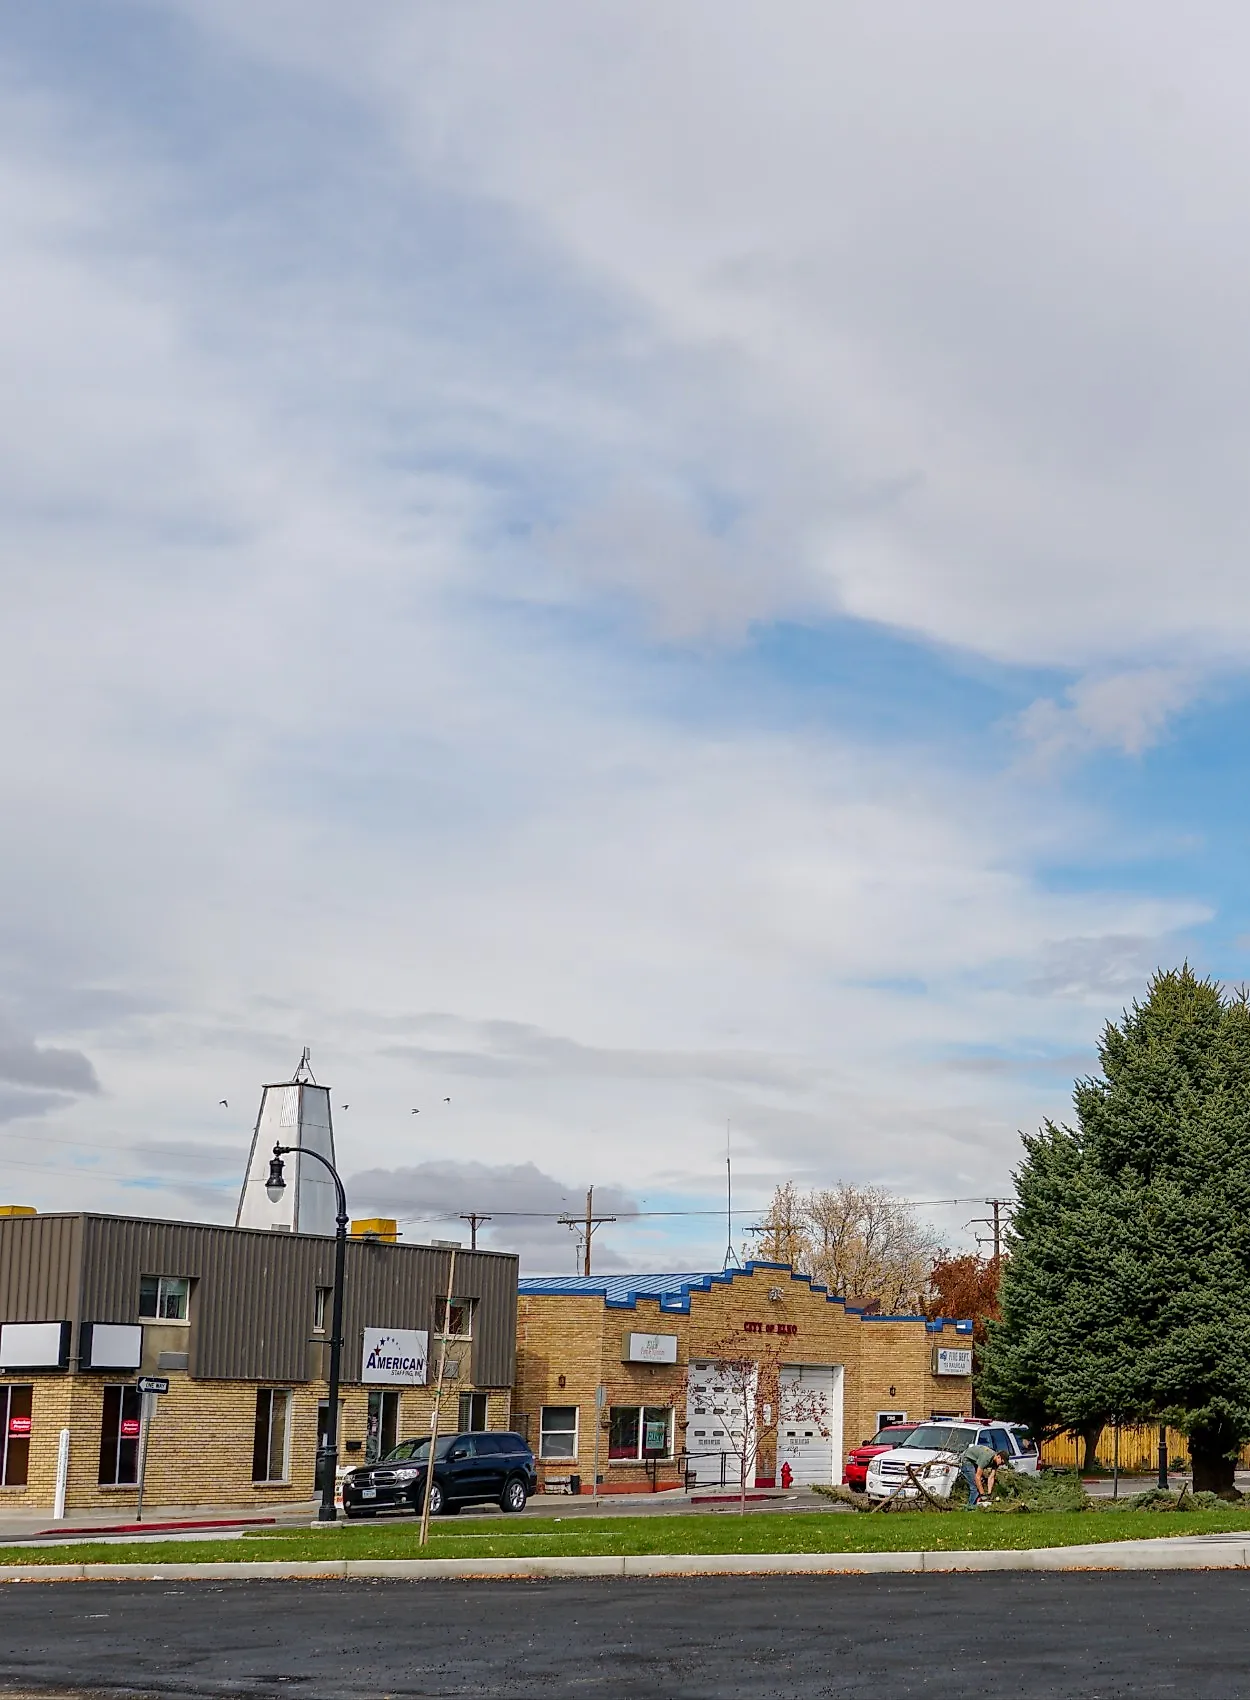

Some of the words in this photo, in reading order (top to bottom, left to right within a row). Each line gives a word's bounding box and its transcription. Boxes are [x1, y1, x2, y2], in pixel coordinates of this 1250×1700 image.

[744, 1321, 762, 1332] CITY
[777, 1324, 797, 1335] ELKO
[366, 1352, 424, 1371] AMERICAN
